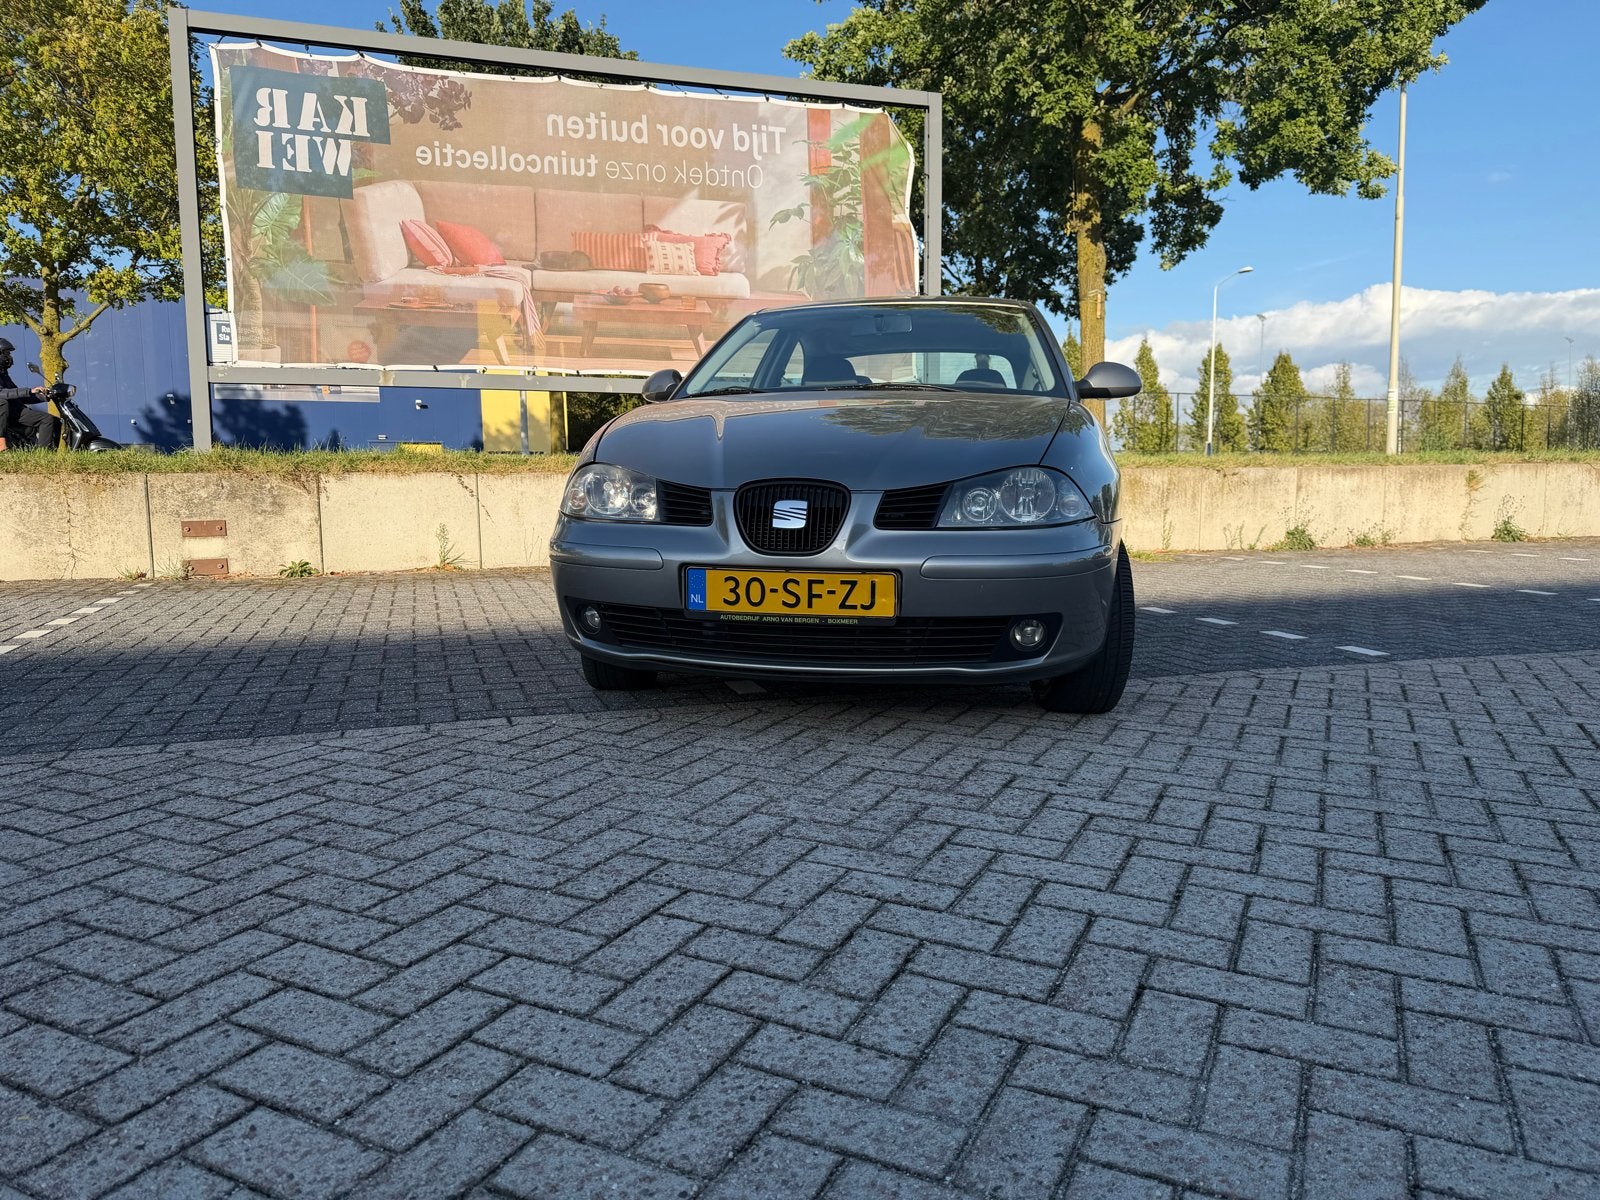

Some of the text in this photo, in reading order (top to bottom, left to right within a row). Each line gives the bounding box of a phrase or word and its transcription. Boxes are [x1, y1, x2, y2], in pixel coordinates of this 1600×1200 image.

[690, 576, 877, 611] NL 30-SF-ZJ
[720, 614, 760, 622] AUTOBEDRIJF
